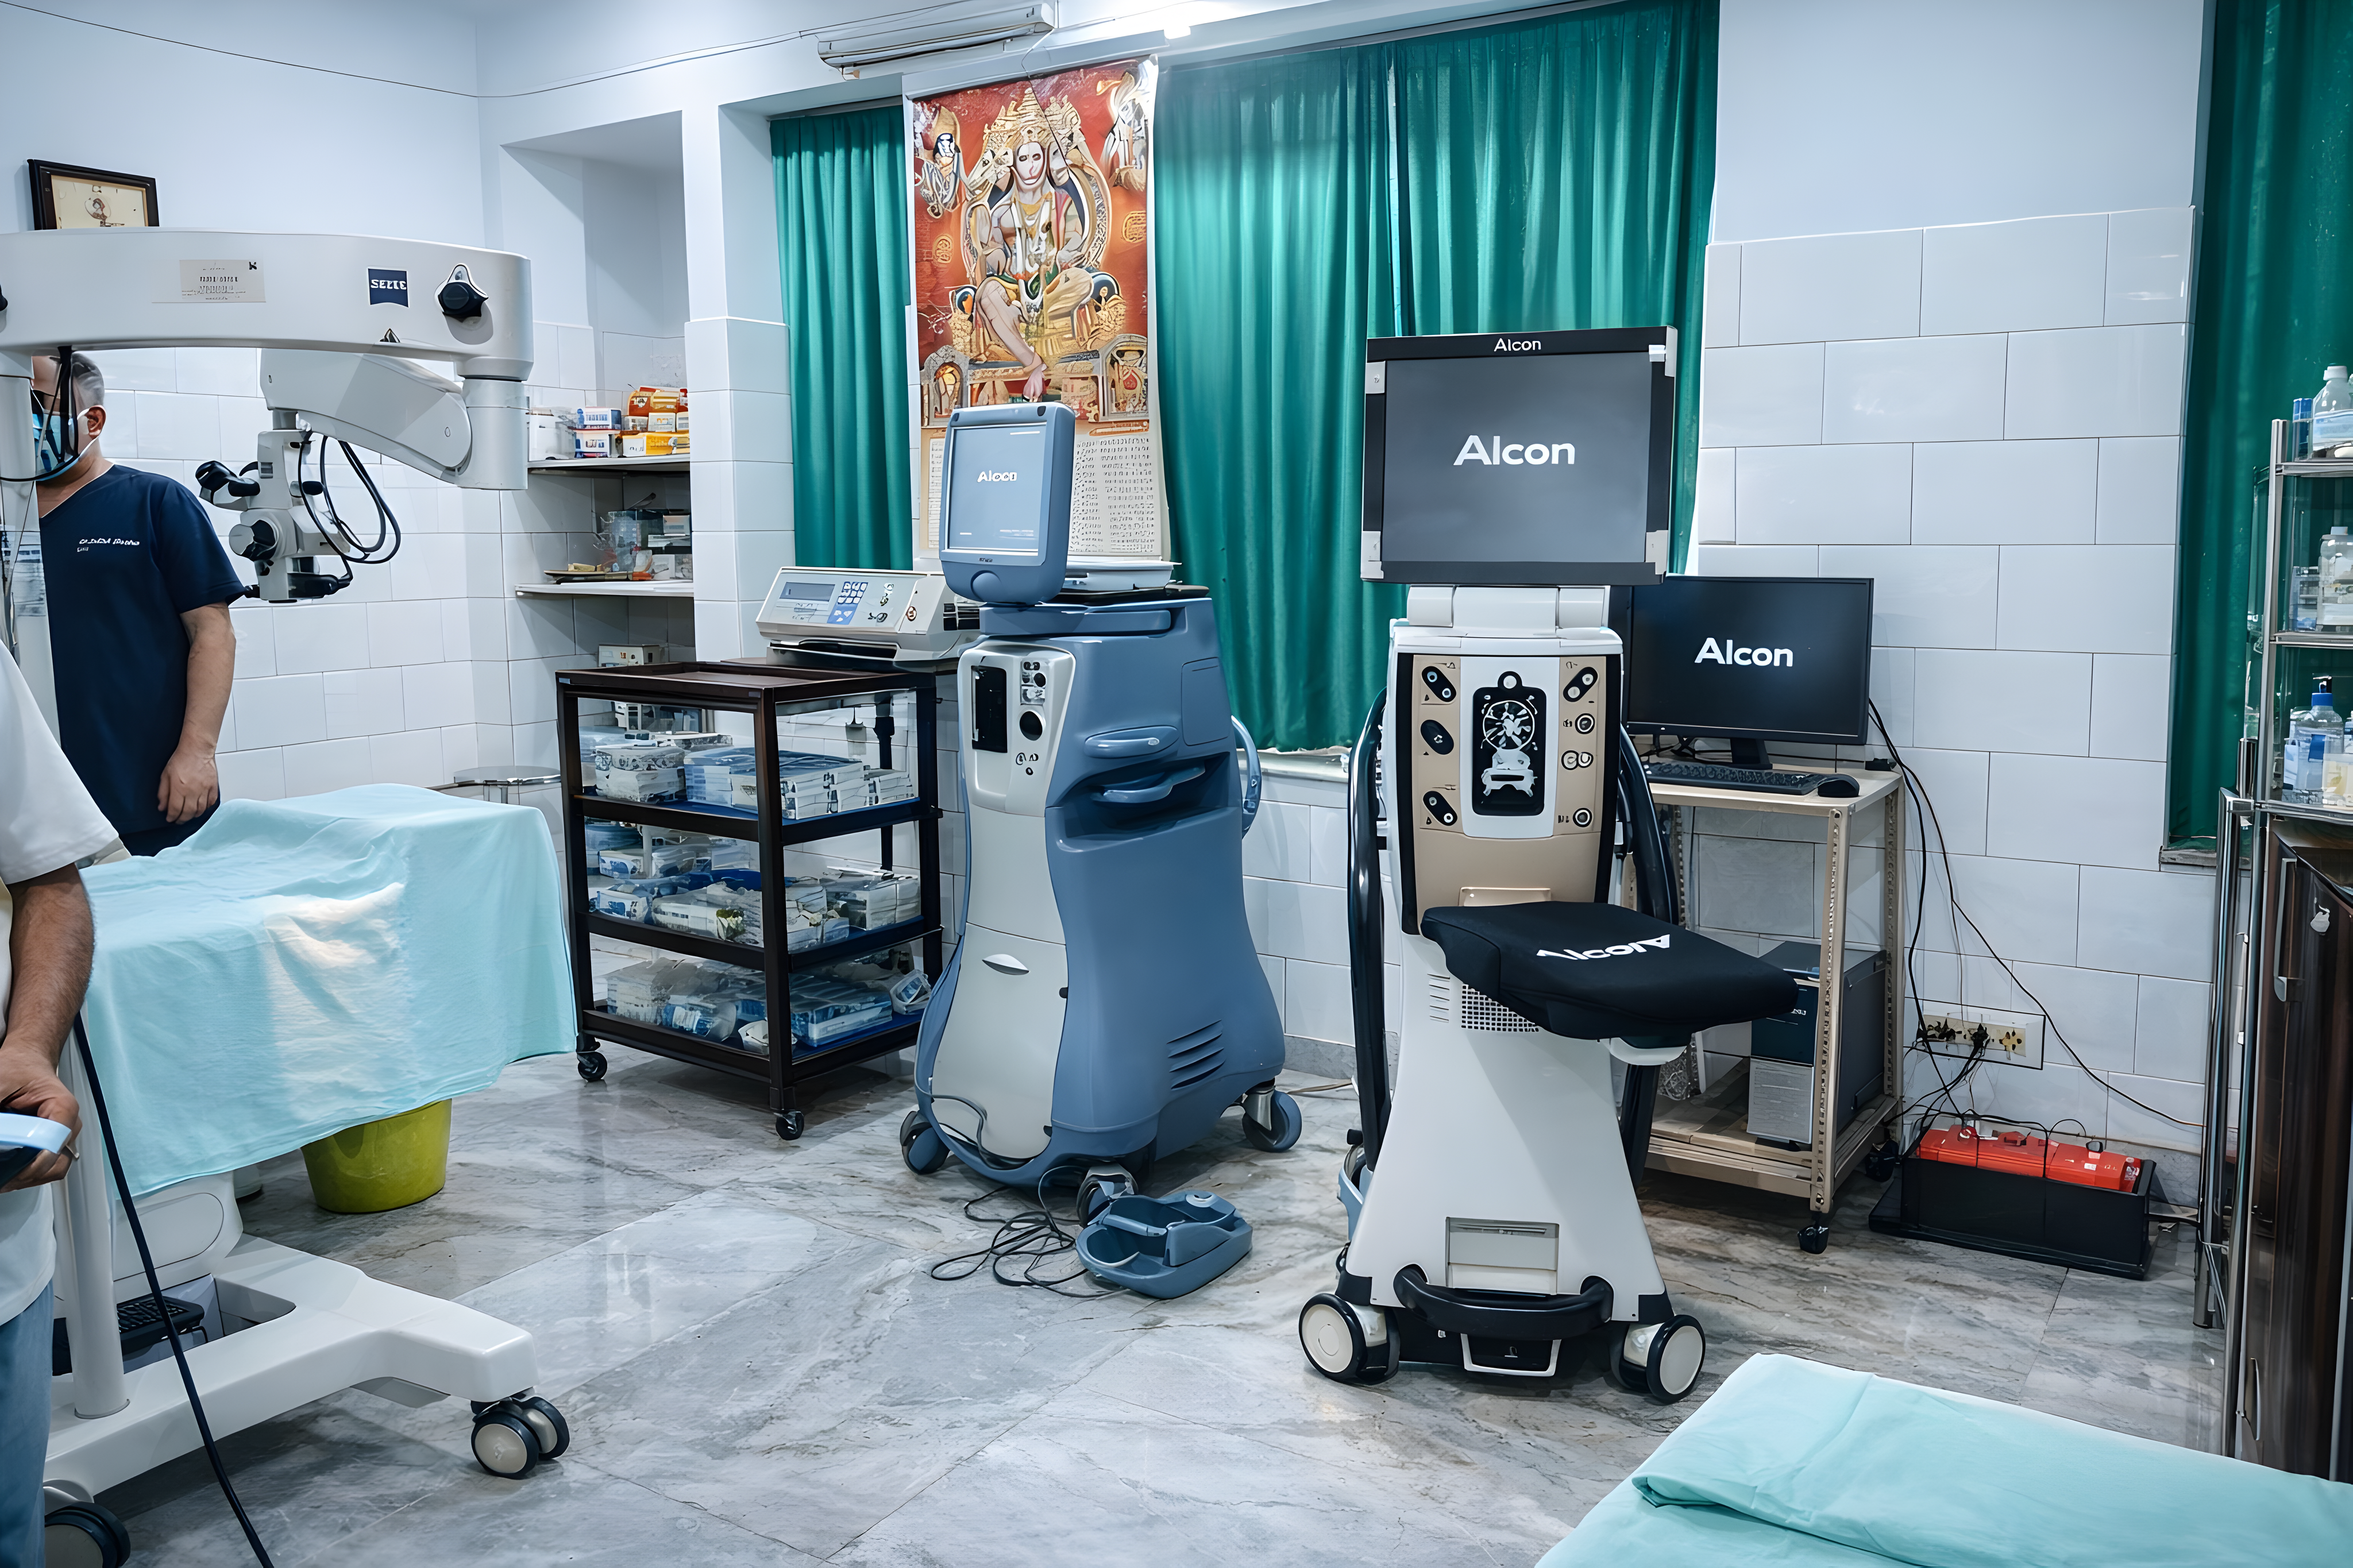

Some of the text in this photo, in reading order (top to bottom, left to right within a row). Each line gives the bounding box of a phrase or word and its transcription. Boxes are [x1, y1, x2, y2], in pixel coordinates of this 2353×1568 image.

[1494, 338, 1541, 352] Alcon
[1453, 435, 1575, 466] Alcon
[1694, 637, 1793, 667] Alcon
